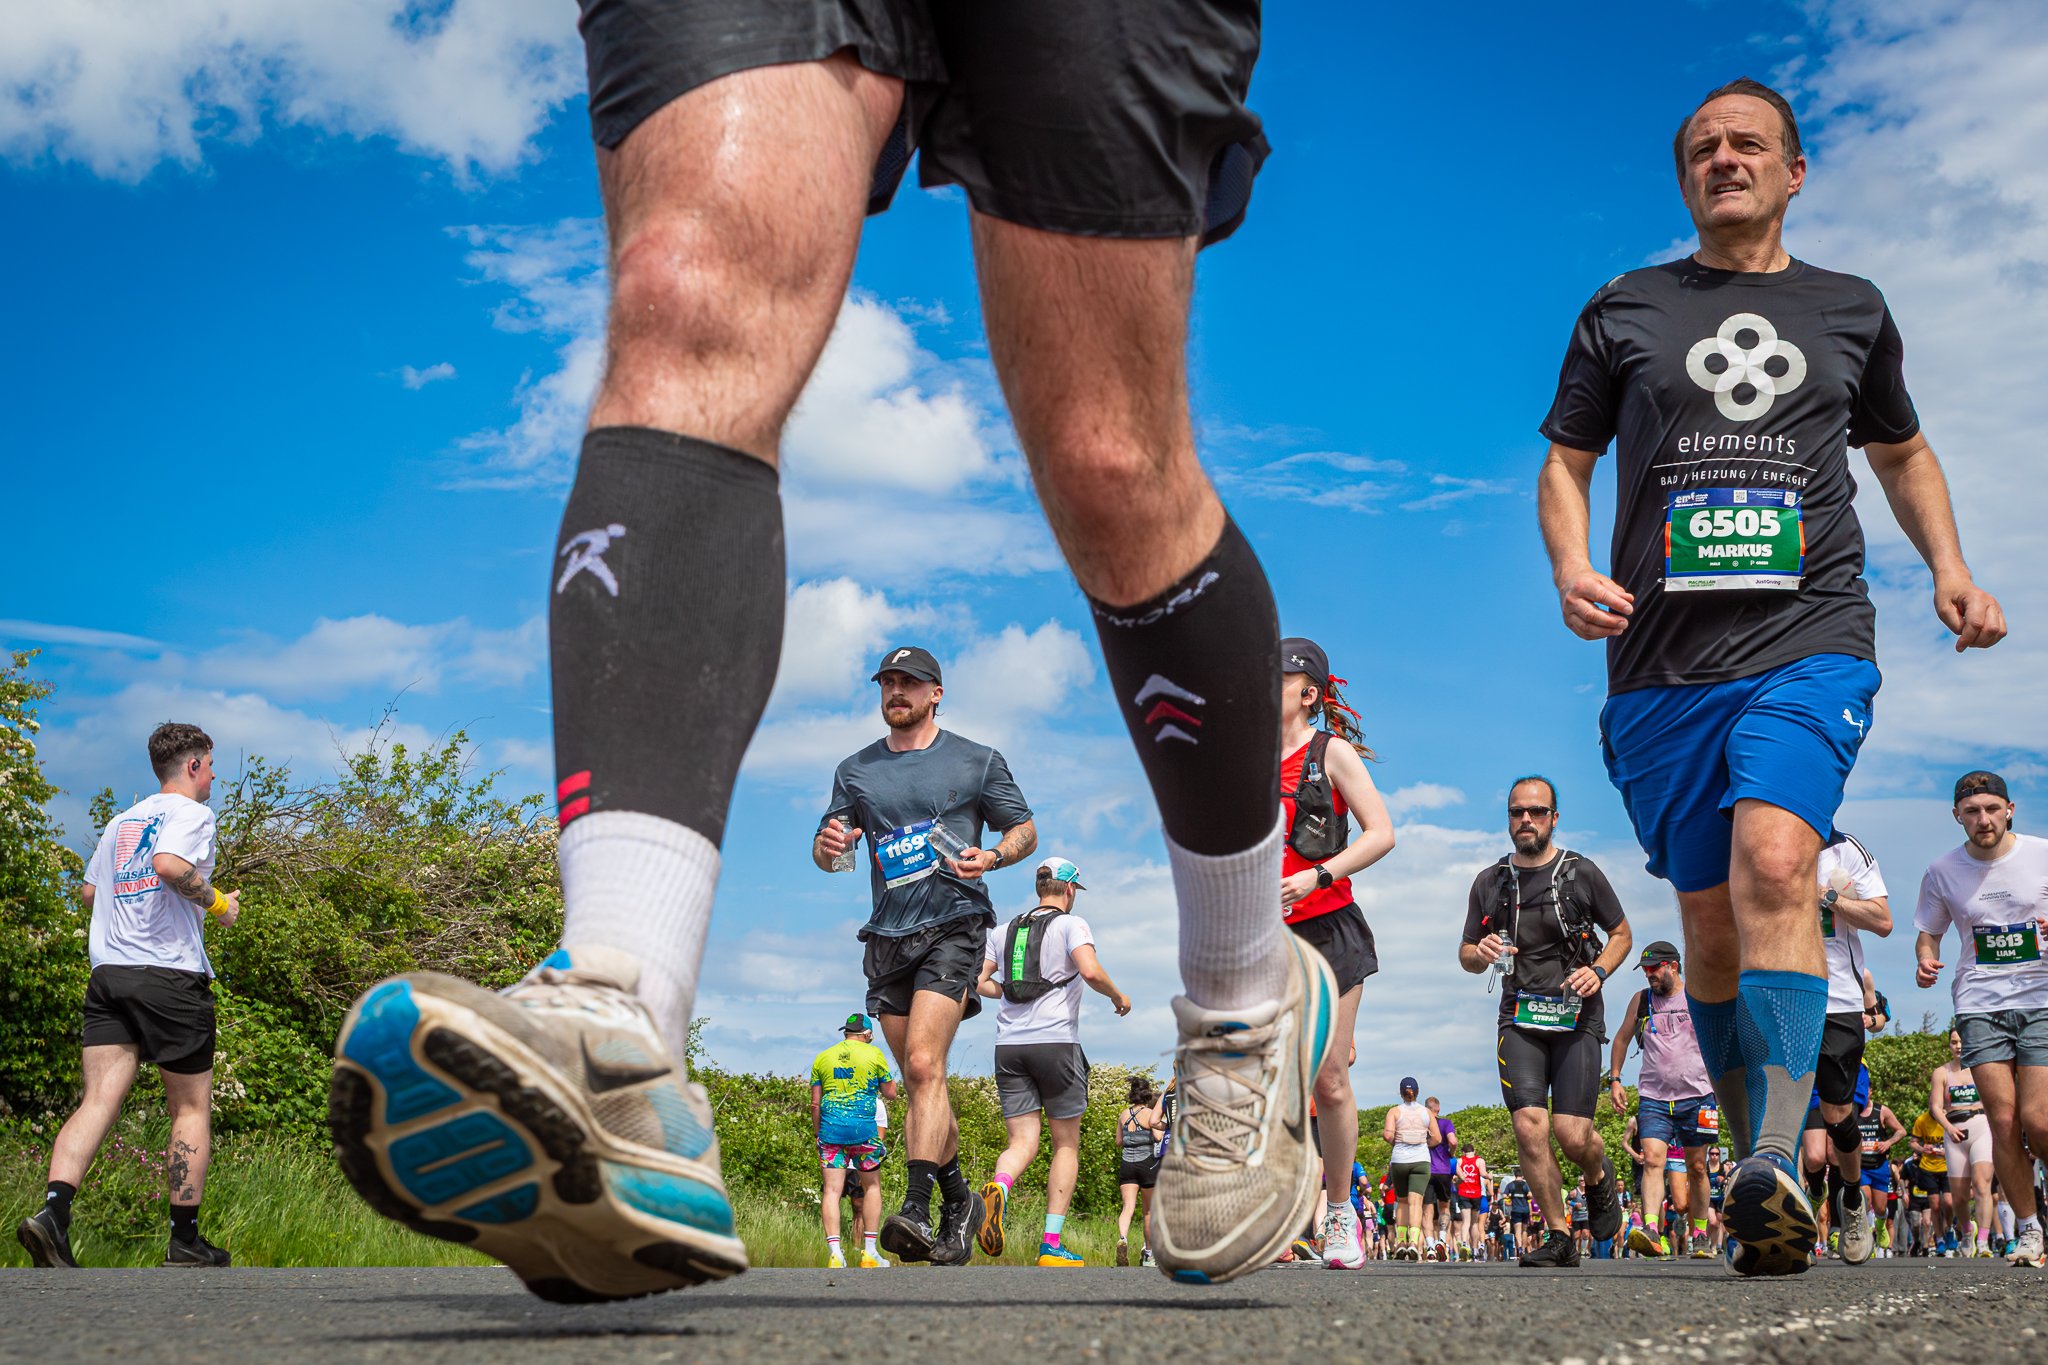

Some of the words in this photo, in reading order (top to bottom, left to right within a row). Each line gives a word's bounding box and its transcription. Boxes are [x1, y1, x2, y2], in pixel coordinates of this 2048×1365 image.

[1678, 431, 1796, 456] elements
[1660, 475, 1679, 486] BAD
[1691, 469, 1747, 481] HEIZUNG
[1762, 471, 1809, 488] ENERGIE
[1689, 509, 1781, 539] 6505
[1698, 543, 1773, 559] MARKUS
[885, 832, 928, 859] 1169
[903, 852, 926, 866] DINO
[1986, 933, 2024, 949] 5613
[1996, 949, 2016, 957] LIAM
[1527, 1000, 1566, 1015] 6550
[1532, 1014, 1560, 1022] STEFAN
[1954, 1087, 1976, 1097] 6492
